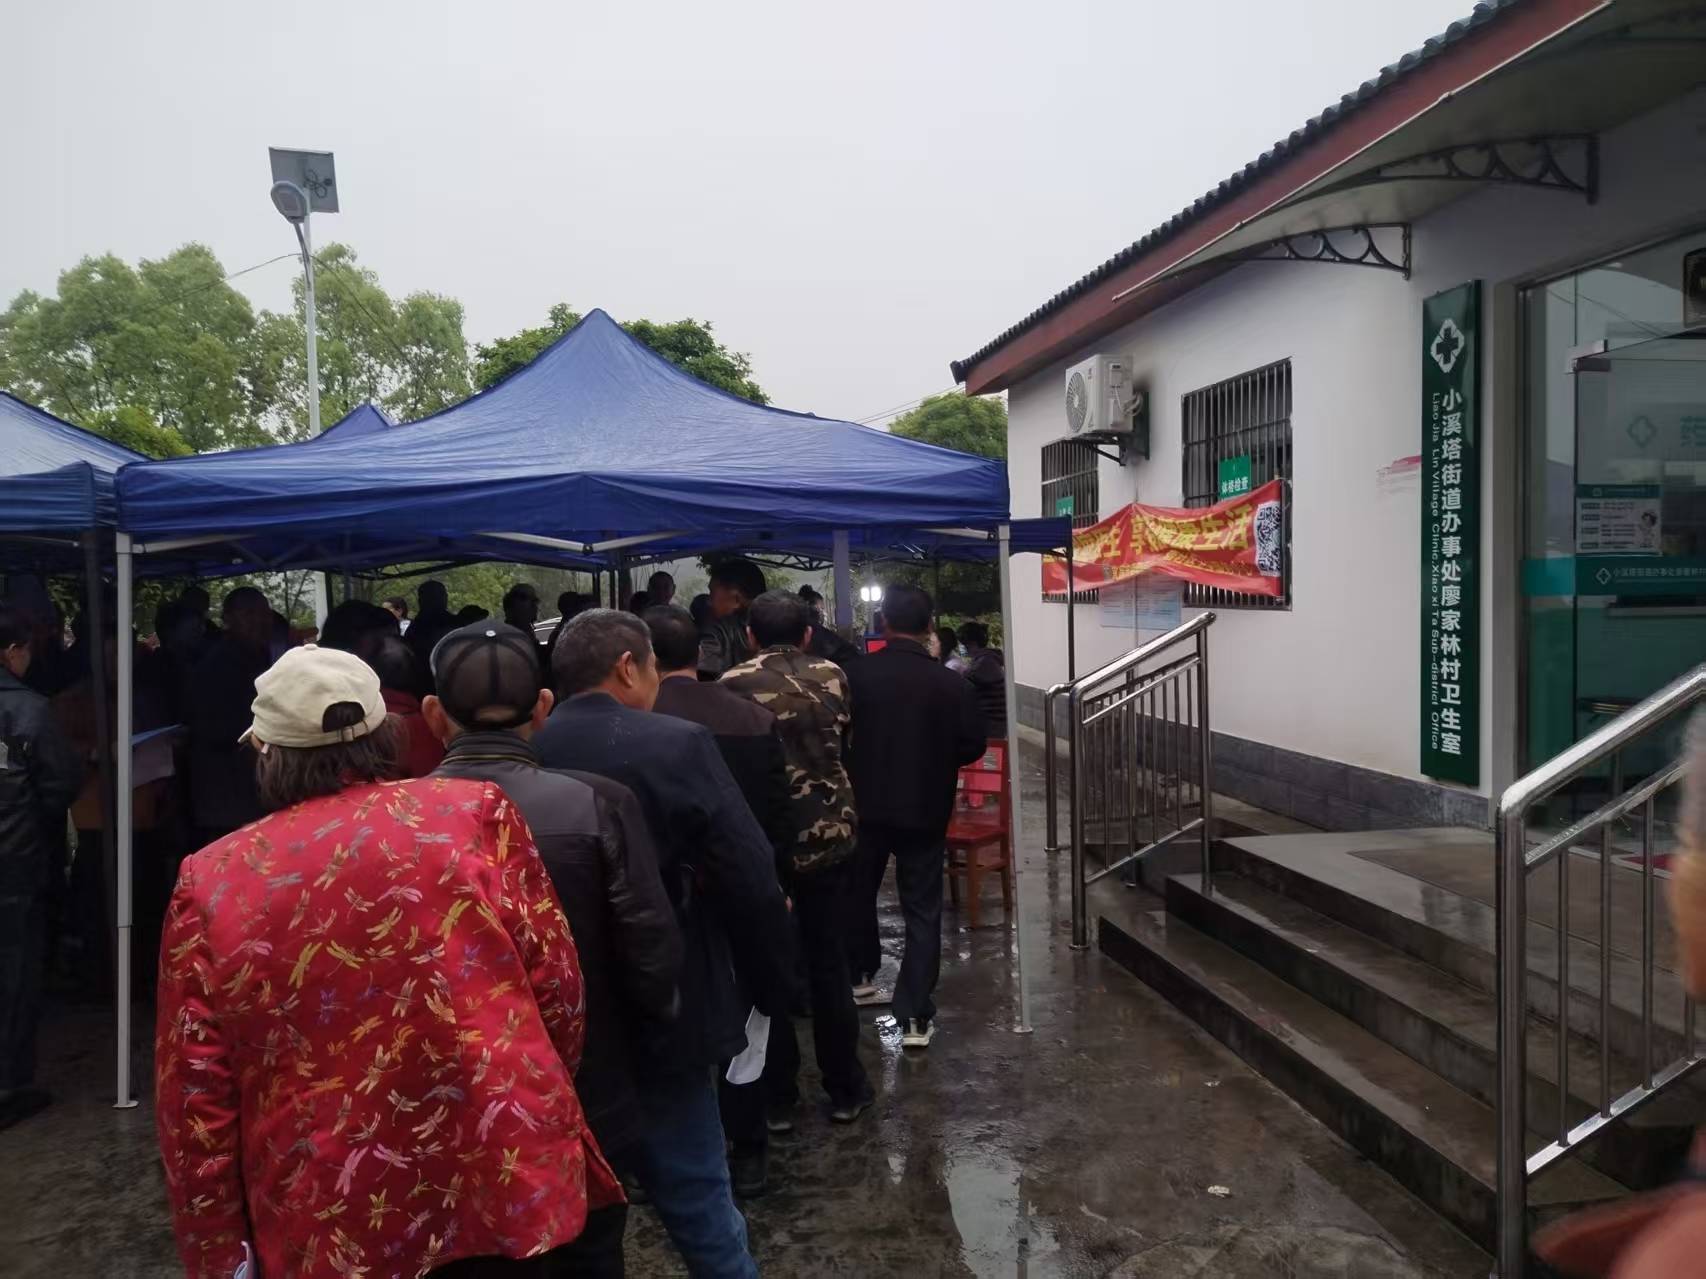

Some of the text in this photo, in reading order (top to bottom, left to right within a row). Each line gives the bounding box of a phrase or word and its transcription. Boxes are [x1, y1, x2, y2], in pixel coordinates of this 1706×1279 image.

[1431, 392, 1440, 420] Liao
[1431, 423, 1440, 442] Jia
[1431, 448, 1440, 468] Lin
[1431, 470, 1440, 517] Village
[1441, 388, 1462, 755] 小溪塔街道办事处廖家林村卫生室
[1431, 609, 1440, 626] Ta
[1431, 629, 1440, 705] Sub-district
[1431, 711, 1440, 750] Office
